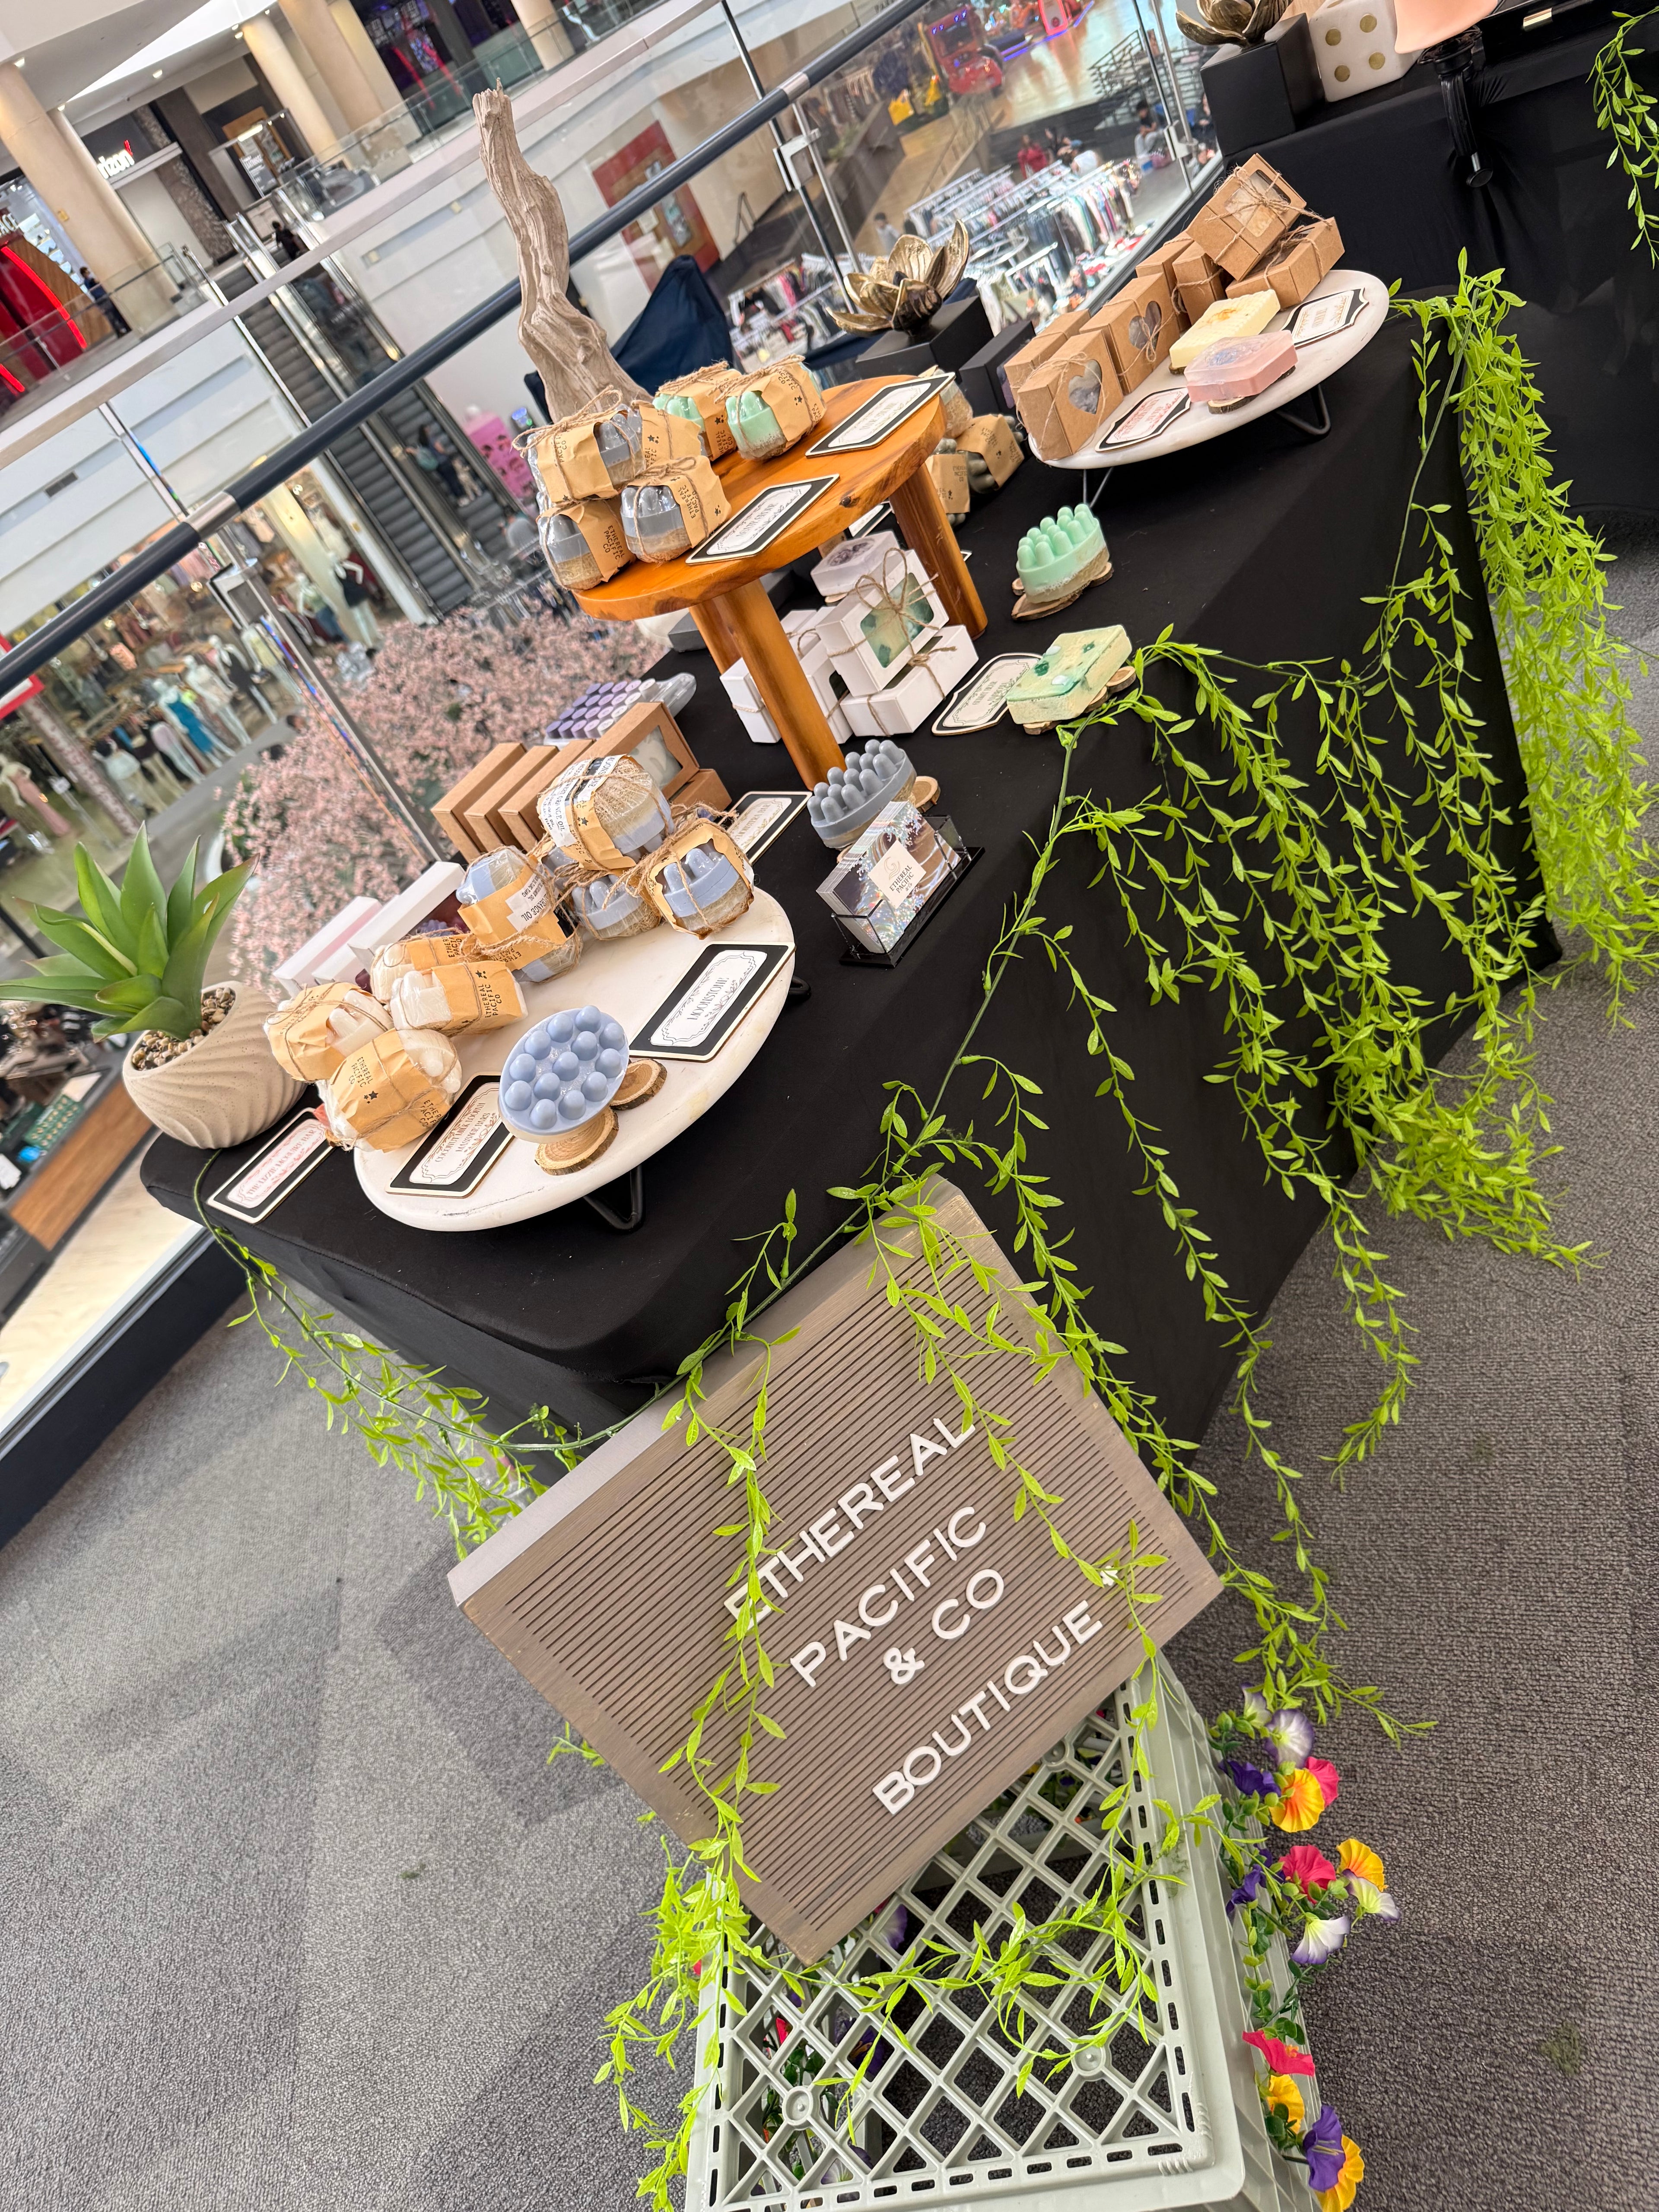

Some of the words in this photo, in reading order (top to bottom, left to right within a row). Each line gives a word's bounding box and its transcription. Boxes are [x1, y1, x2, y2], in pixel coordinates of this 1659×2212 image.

[97, 149, 135, 179] rizon
[561, 440, 567, 450] CO
[720, 430, 729, 450] CIFIC
[728, 436, 733, 445] CO
[678, 487, 696, 519] ETHEREAL
[683, 484, 700, 513] PACIFIC
[603, 543, 610, 553] CO
[604, 531, 620, 559] PACIFIC
[608, 525, 625, 558] ETHEREAL
[890, 865, 912, 891] ETHEREAL
[896, 872, 914, 893] PACIFIC
[521, 912, 532, 921] OIL
[449, 937, 459, 955] PACIF
[501, 952, 521, 963] ETHER
[478, 984, 491, 1018] ETHEREAL
[485, 984, 499, 1016] PACIFIC
[495, 995, 502, 1004] CO
[687, 978, 729, 1020] MOONSTONE
[349, 1075, 355, 1084] CO
[352, 1063, 366, 1087] PACIFIC
[357, 1057, 373, 1084] ETHEREAL
[420, 1106, 437, 1126] PACIF
[424, 1100, 443, 1120] ETHER
[435, 1137, 459, 1162] COCONUT
[455, 1123, 470, 1137] MILK
[465, 1103, 486, 1123] LOOFAH
[455, 1128, 478, 1152] MASSAGE
[475, 1112, 490, 1127] BARS
[246, 1183, 260, 1195] THE
[259, 1166, 277, 1184] LIZZIE
[301, 1129, 315, 1142] BAR
[724, 1418, 975, 1629] ETHEREAL
[790, 1506, 986, 1688] PACIFIC
[883, 1647, 925, 1685] &
[931, 1568, 1004, 1640] CO
[872, 1600, 1103, 1815] BOUTIQUE
